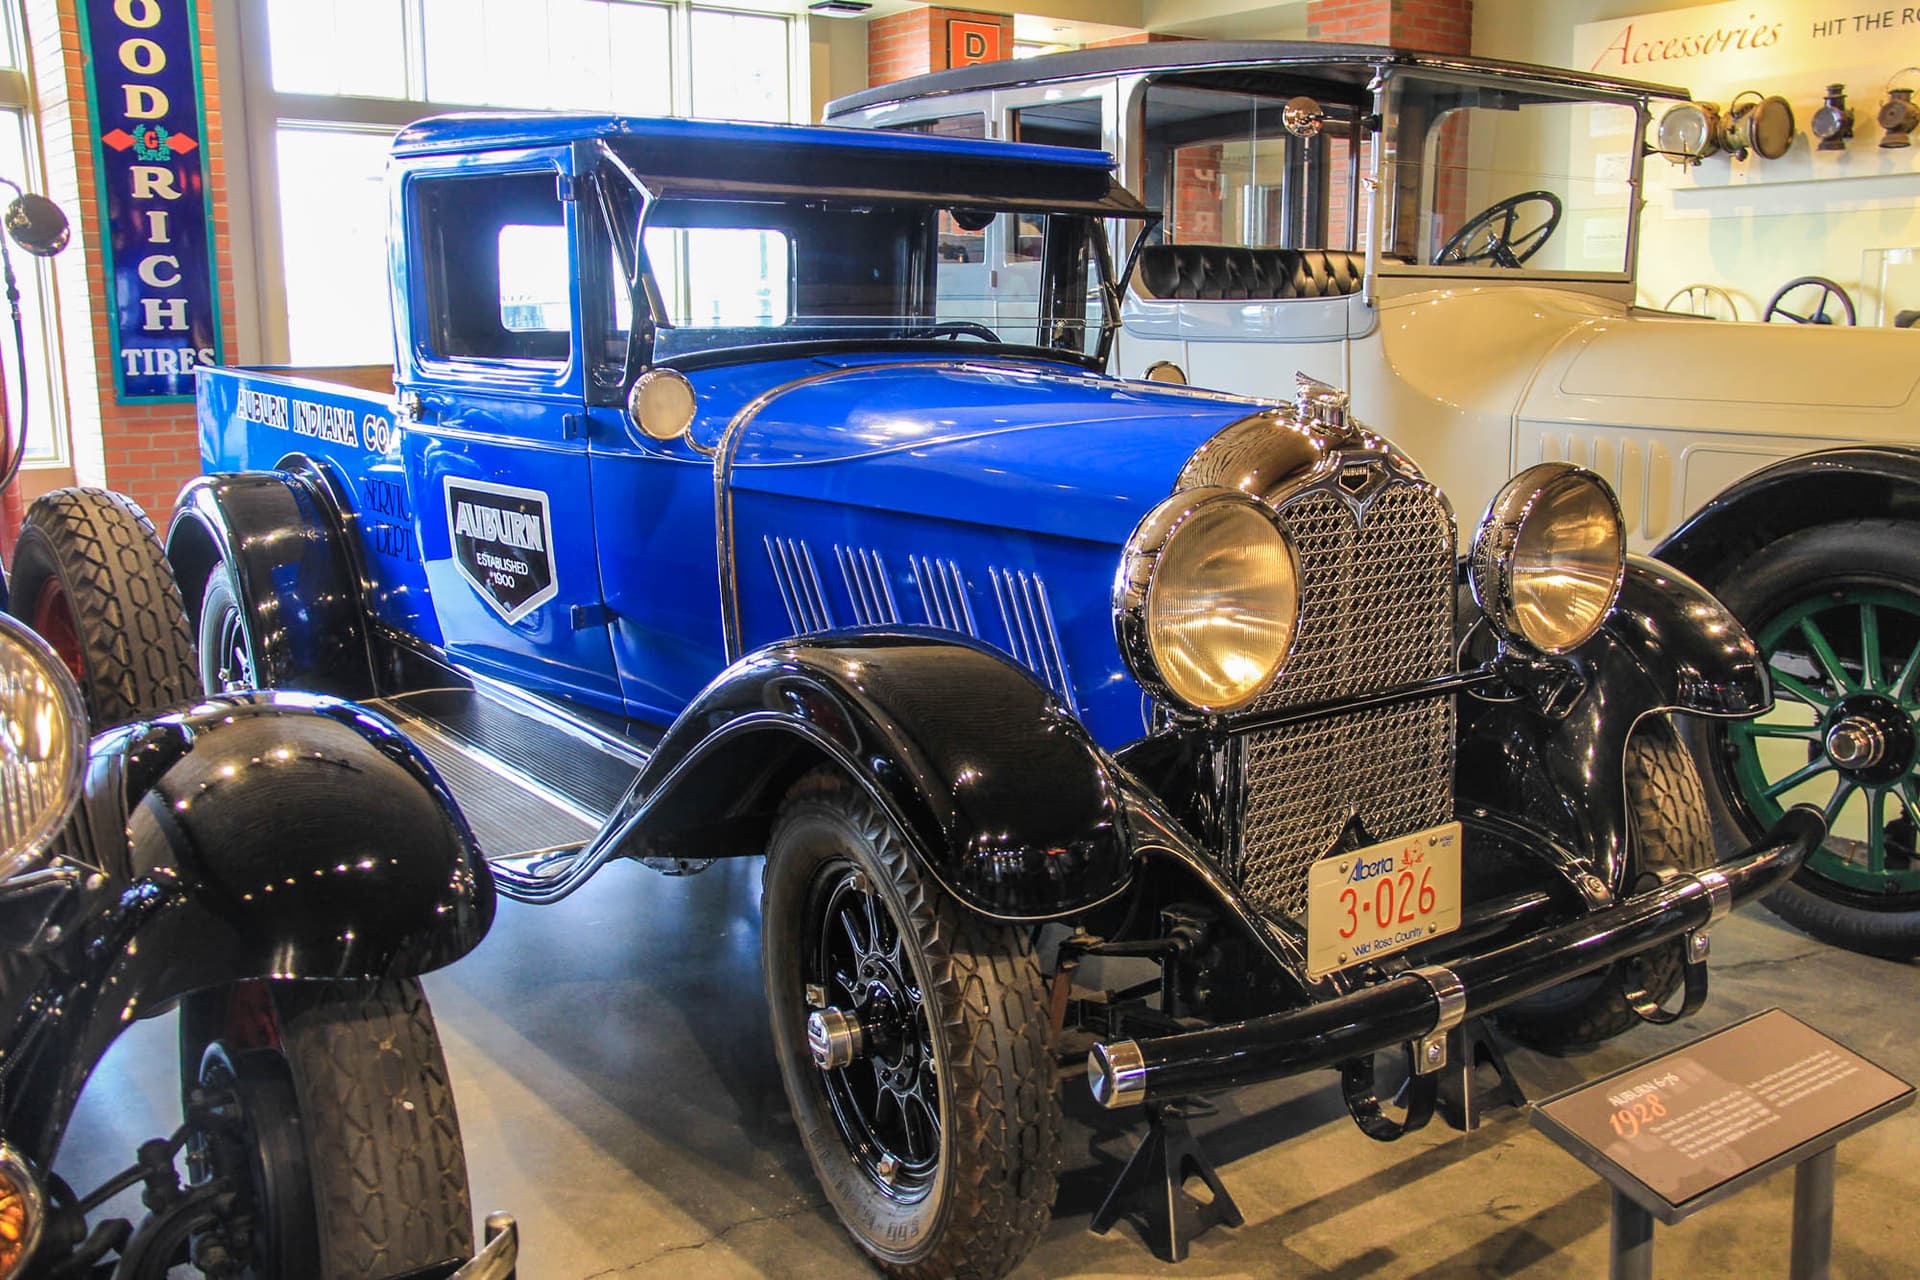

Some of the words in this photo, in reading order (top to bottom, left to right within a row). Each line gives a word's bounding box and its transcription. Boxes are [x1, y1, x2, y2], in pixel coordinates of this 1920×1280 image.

[1590, 13, 1782, 72] Accessories
[1812, 17, 1846, 39] HIT
[1853, 10, 1895, 33] THE
[1901, 7, 1920, 25] R
[121, 348, 216, 376] TIRES
[237, 388, 289, 431] AUBURN
[292, 399, 359, 448] INDIANA
[455, 501, 545, 553] AUBURN
[476, 552, 529, 576] ESTABLISHED
[1347, 857, 1394, 885] Alberta
[1352, 944, 1371, 957] Wild
[1373, 937, 1394, 949] Rose
[1394, 926, 1424, 944] Country
[1608, 1081, 1658, 1107] AUBURN
[1609, 1093, 1668, 1139] 1928
